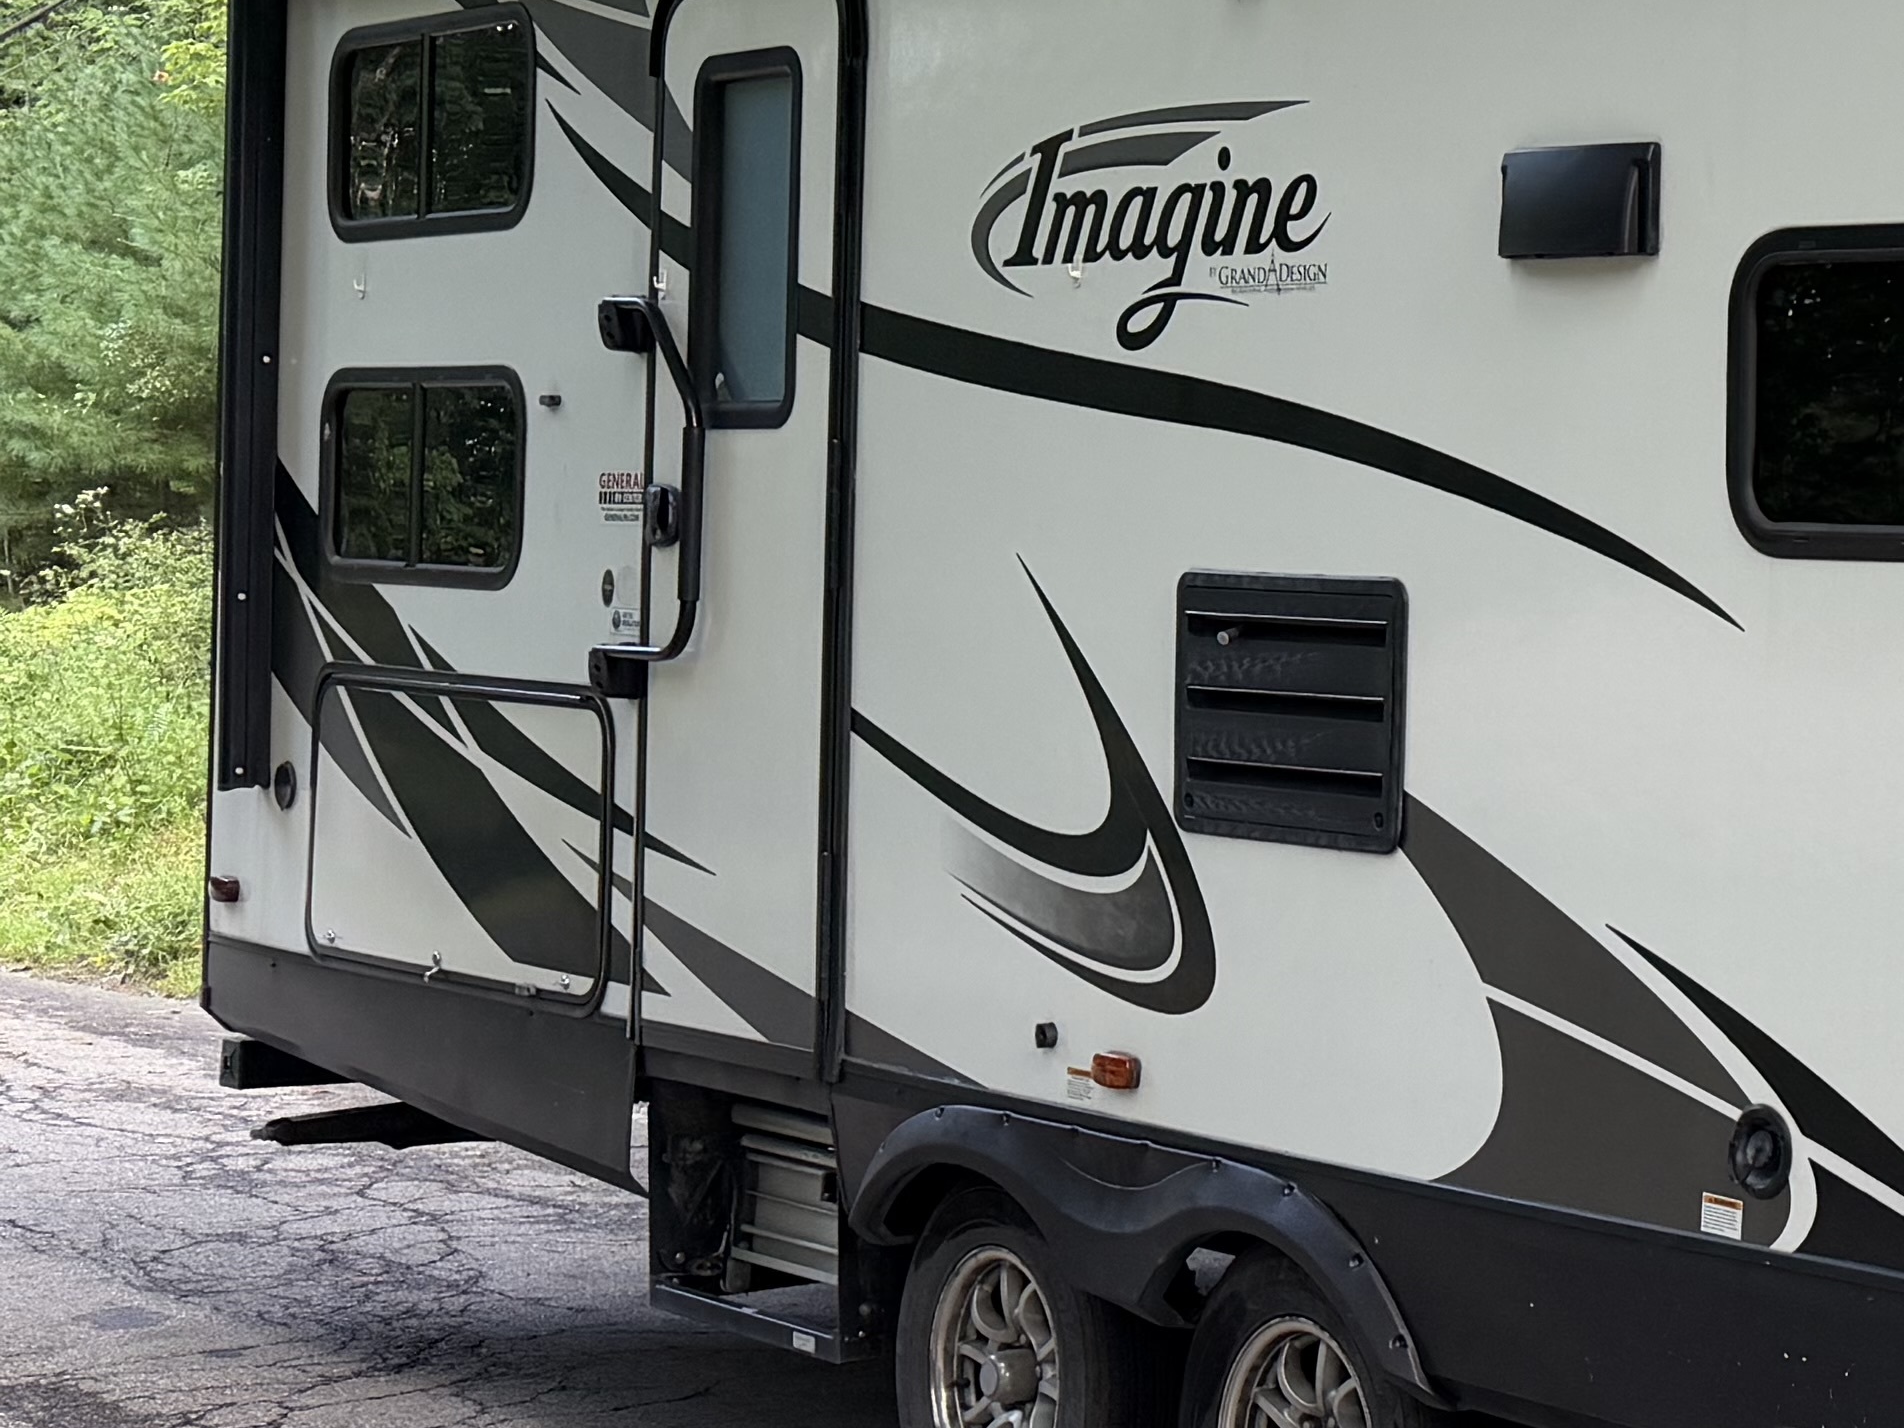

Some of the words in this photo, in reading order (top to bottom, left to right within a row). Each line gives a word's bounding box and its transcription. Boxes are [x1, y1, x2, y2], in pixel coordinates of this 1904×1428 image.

[1002, 126, 1332, 351] Imagine
[1218, 265, 1267, 286] GRAND
[1279, 262, 1328, 283] DESIGN
[598, 472, 645, 490] GENERAL
